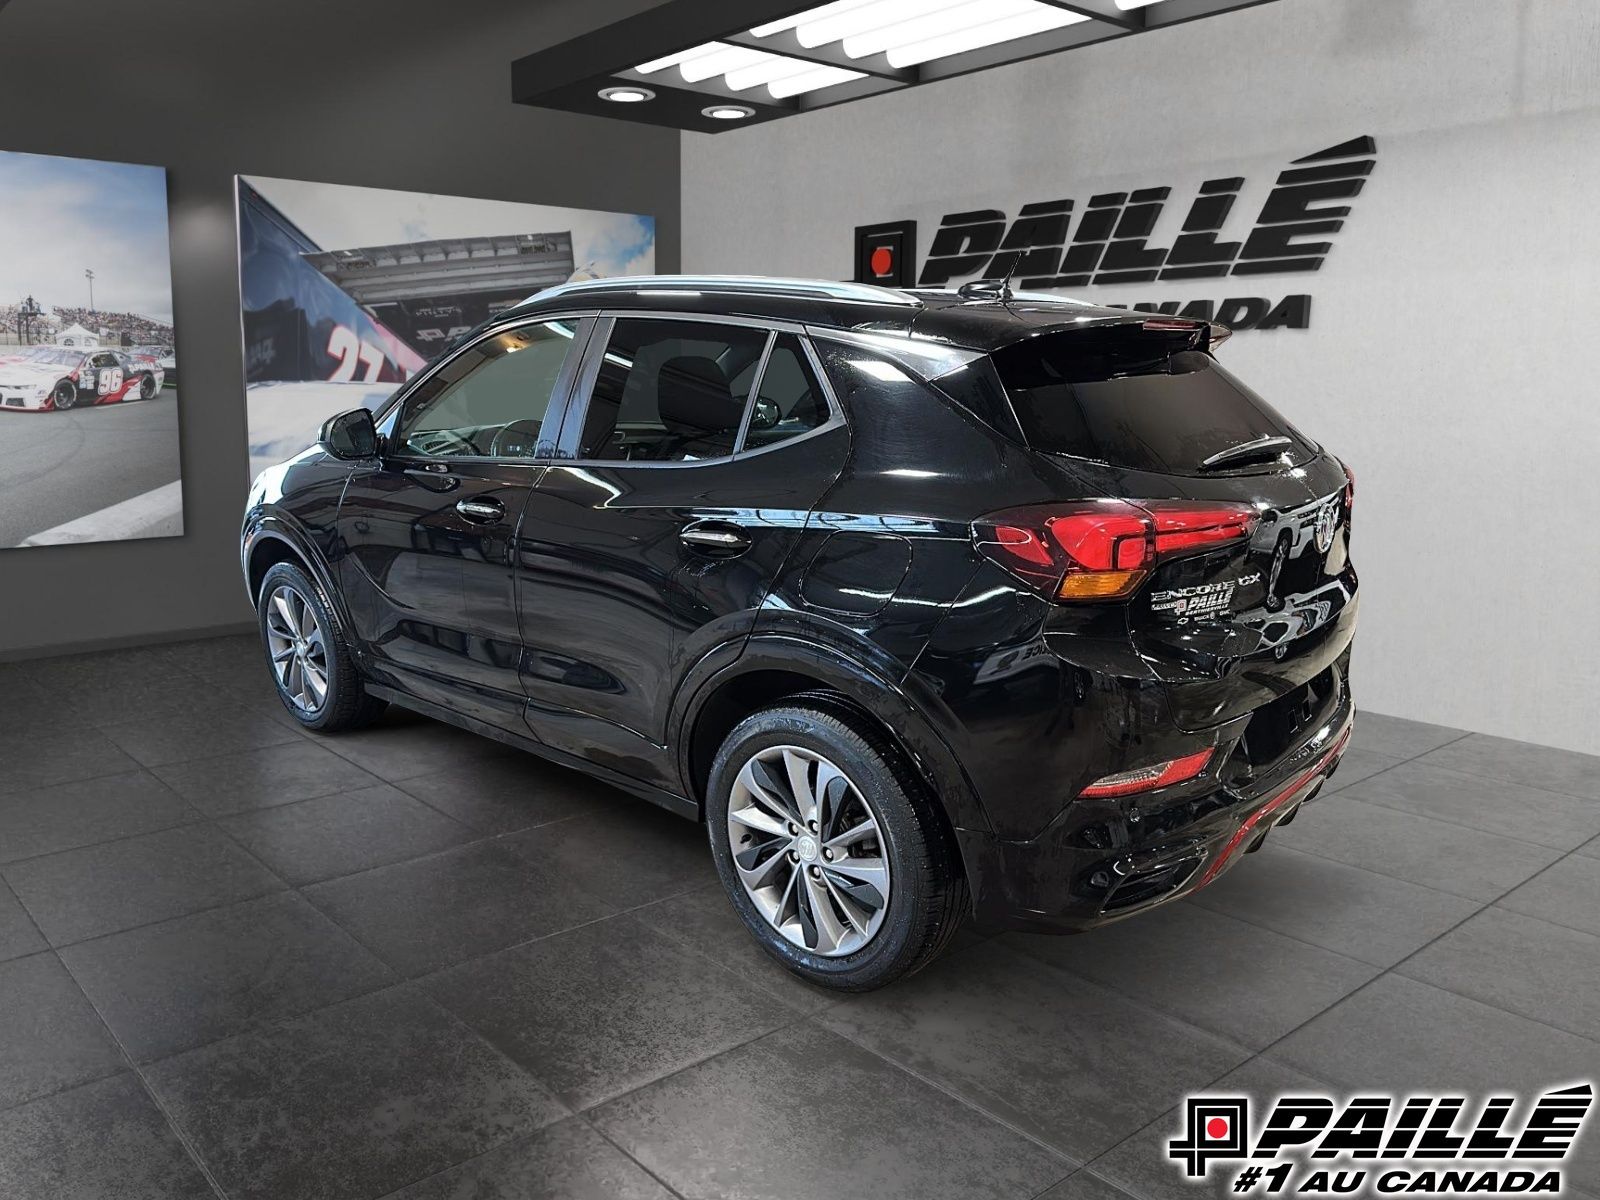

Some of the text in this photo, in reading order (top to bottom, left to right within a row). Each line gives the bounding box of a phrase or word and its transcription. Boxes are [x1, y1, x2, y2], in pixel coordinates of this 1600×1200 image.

[918, 135, 1377, 290] PAILLÉ
[327, 325, 385, 383] 27
[98, 367, 123, 395] 96
[1151, 572, 1261, 602] ENCORE GX
